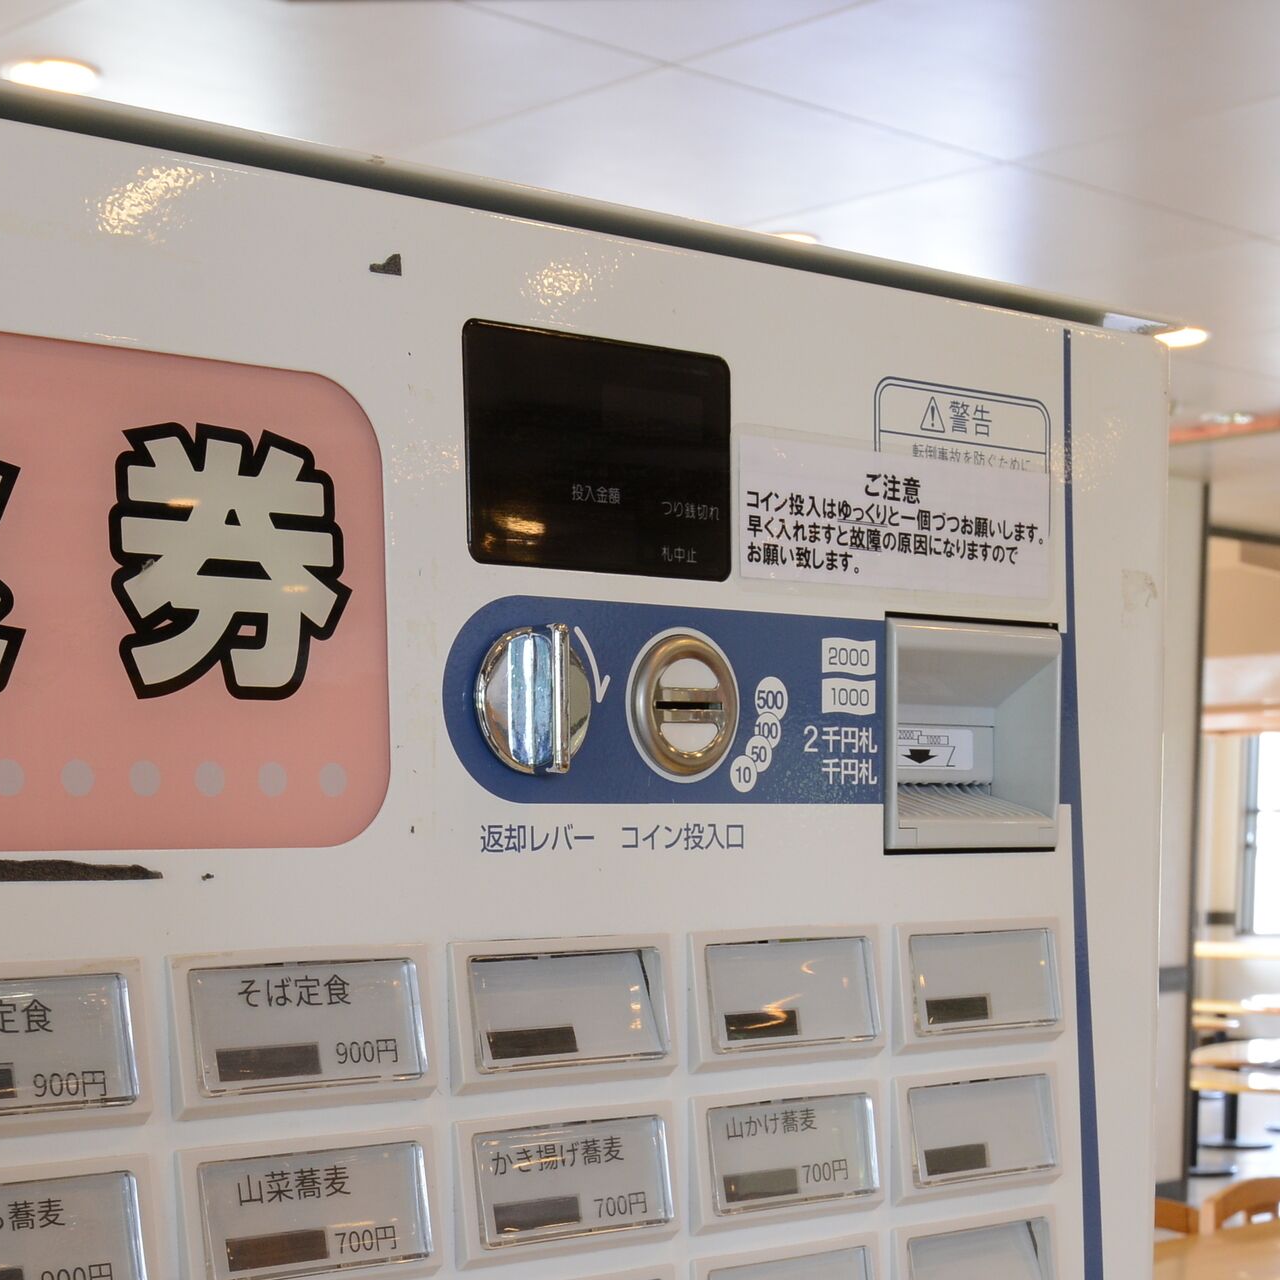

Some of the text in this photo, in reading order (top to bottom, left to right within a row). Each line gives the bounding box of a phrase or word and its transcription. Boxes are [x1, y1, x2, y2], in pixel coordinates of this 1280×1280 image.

[949, 400, 992, 437] 警告
[571, 484, 621, 505] 投入金額
[864, 473, 921, 504] ご注意
[661, 501, 720, 521] つり銭切れ
[746, 489, 1044, 546] コイン投入はゆっくりと一個づつお願いします。
[661, 546, 698, 564] 札中止
[747, 515, 1018, 566] 早く入れますと故障の原因になりますので
[747, 542, 860, 574] お願い致します。
[828, 647, 870, 667] 2000
[756, 690, 784, 710] 500
[831, 687, 870, 707] 1000
[757, 722, 779, 739] 100
[803, 725, 878, 754] 2千円札
[750, 746, 768, 763] 50
[735, 766, 752, 783] 10
[822, 759, 878, 786] 千円札
[480, 823, 595, 853] 返却レバー
[621, 822, 744, 851] コイン投入口
[237, 974, 352, 1009] そば定食
[335, 1038, 400, 1065] 900円
[33, 1070, 108, 1099] 900円
[726, 1107, 818, 1141] 山かけ蕎麦
[491, 1135, 625, 1177] かき揚げ蕎麦
[236, 1164, 352, 1207] 山菜蕎麦
[802, 1158, 850, 1185] 700円
[593, 1190, 649, 1219] 700円
[334, 1225, 399, 1256] 700円
